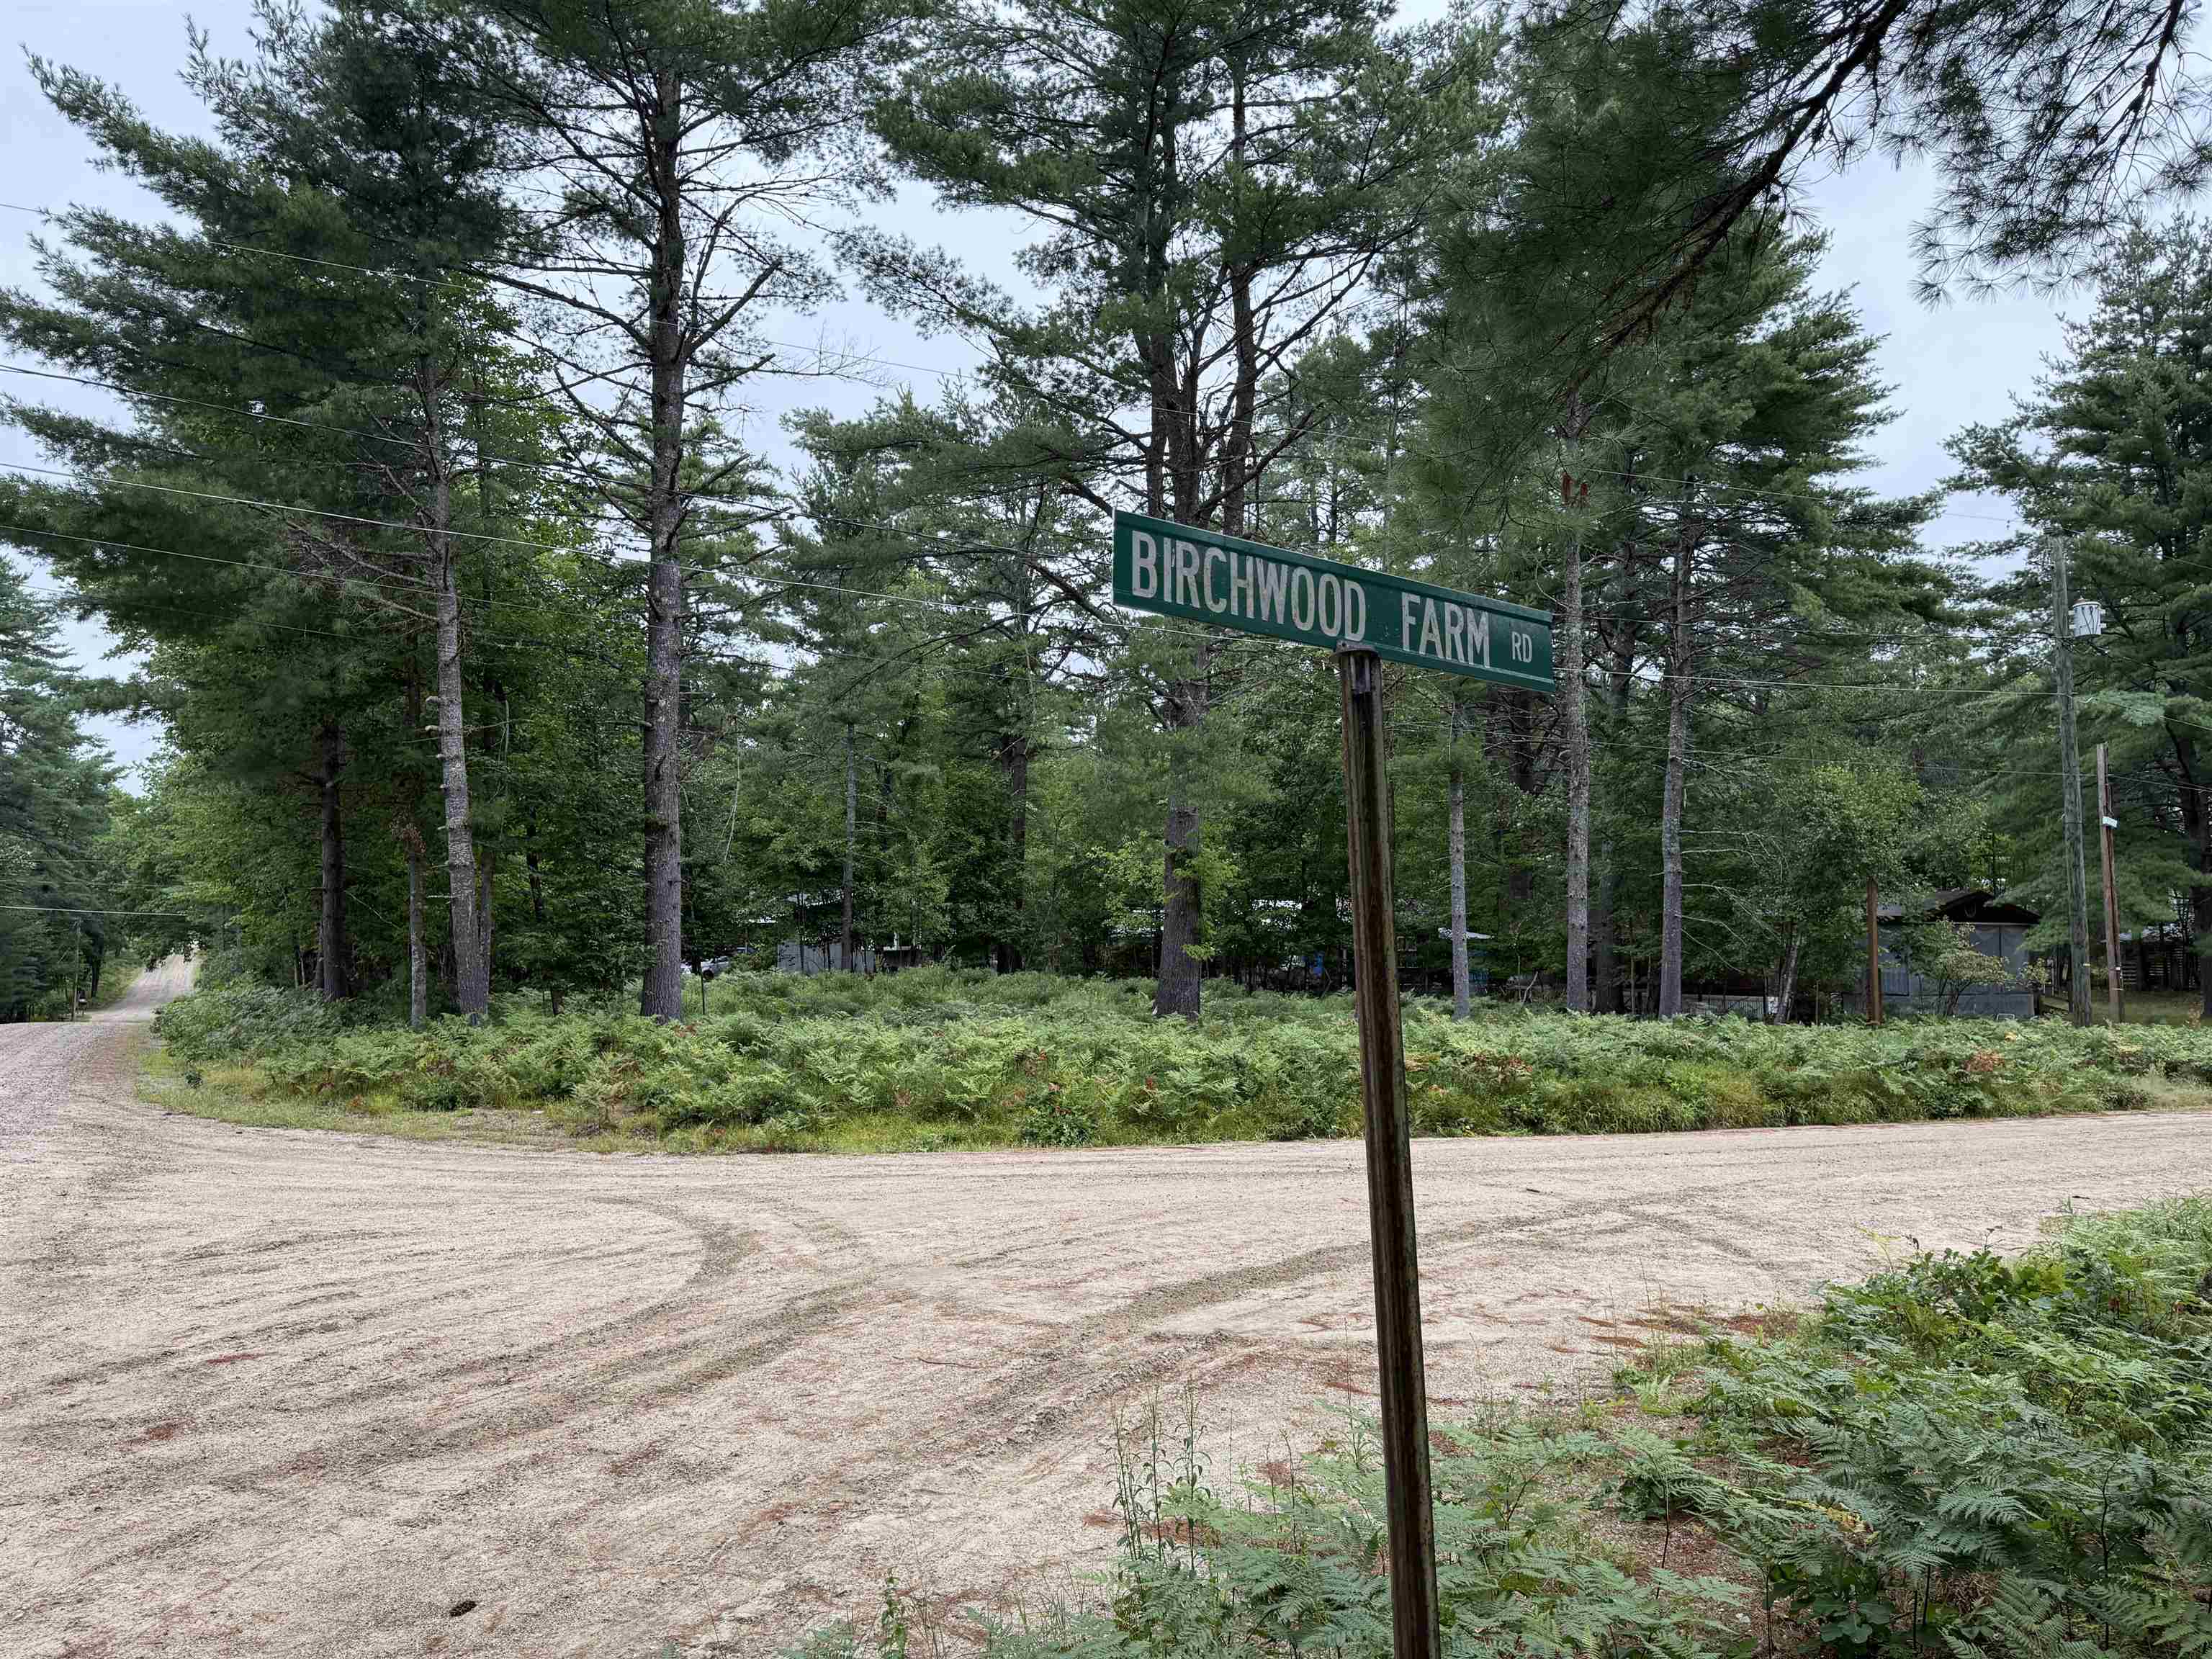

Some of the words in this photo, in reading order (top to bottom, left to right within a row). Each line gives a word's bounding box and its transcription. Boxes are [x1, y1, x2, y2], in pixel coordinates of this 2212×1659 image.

[1132, 530, 1366, 642] BIRCHWOOD
[1402, 592, 1490, 668] FARM
[1512, 631, 1532, 663] RD
